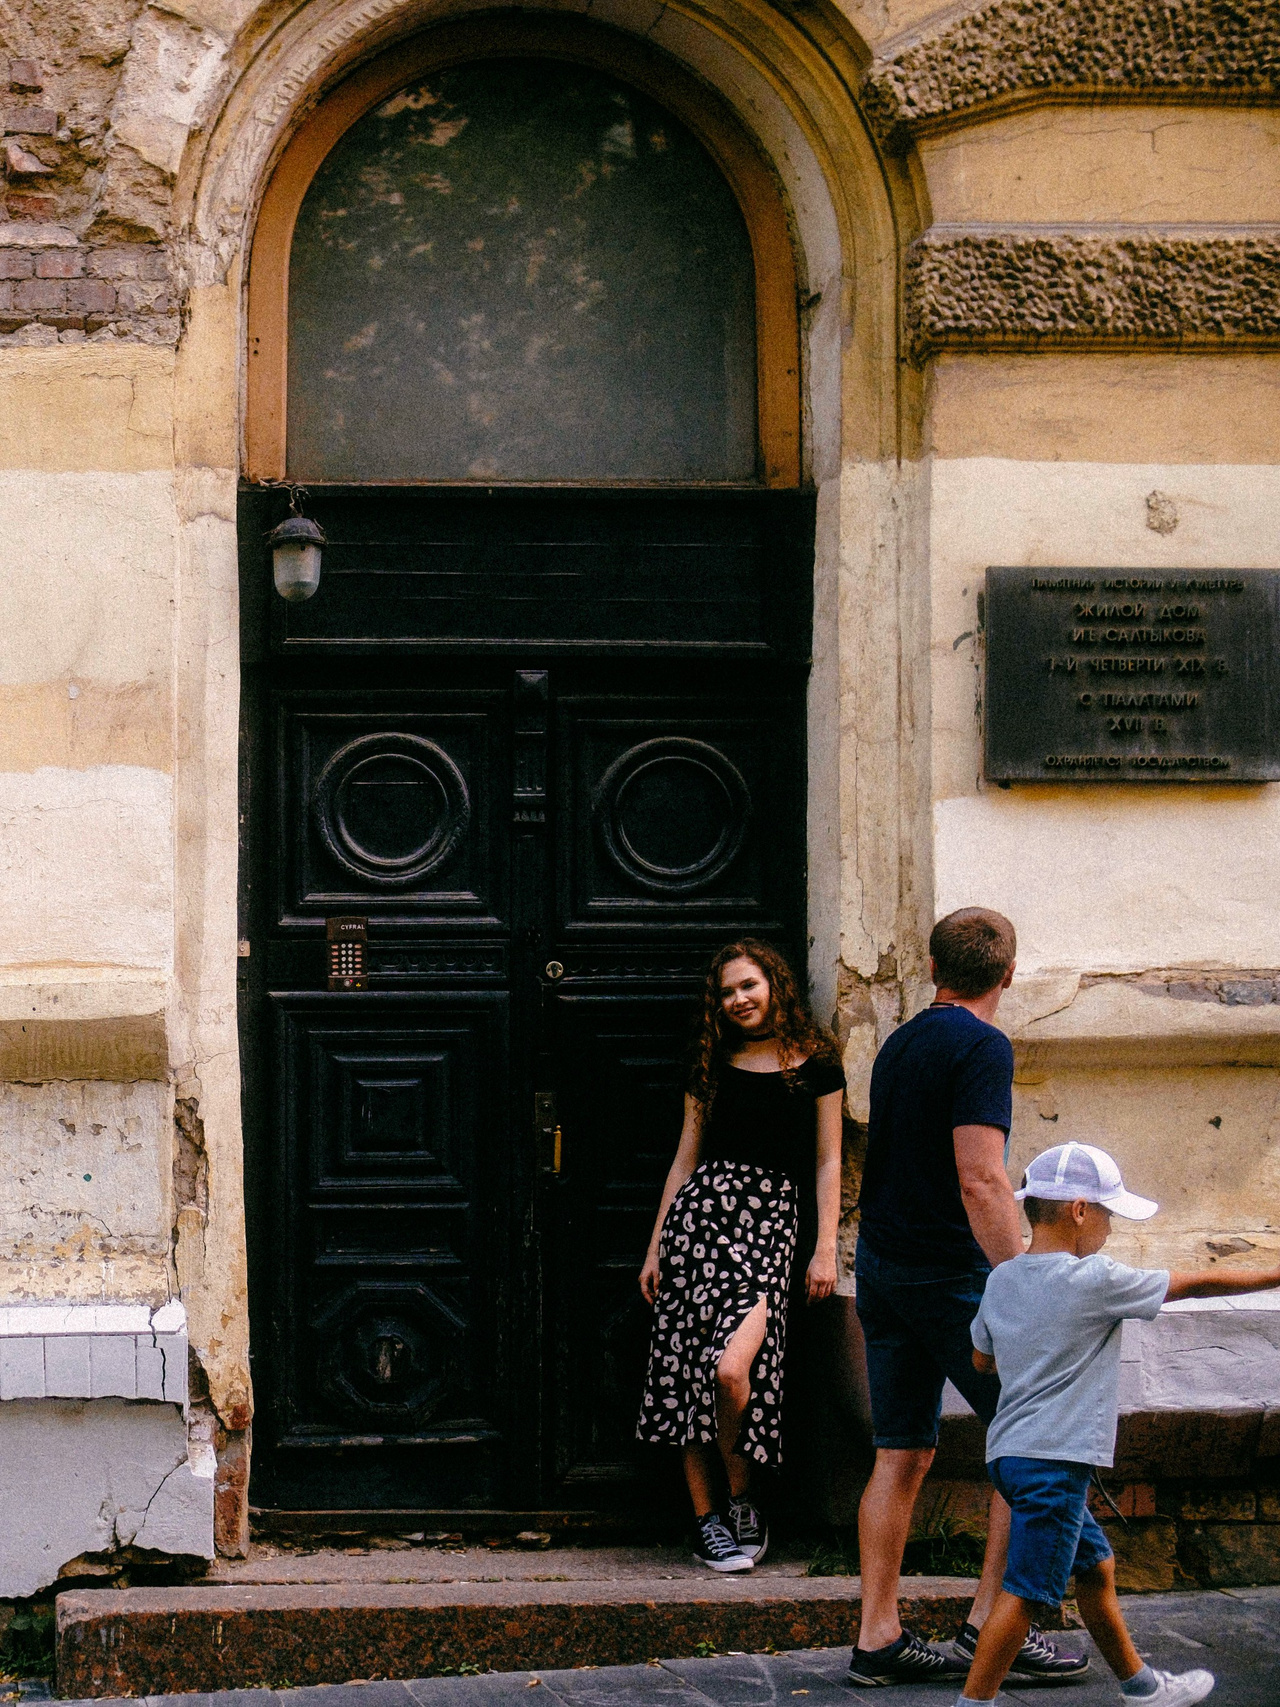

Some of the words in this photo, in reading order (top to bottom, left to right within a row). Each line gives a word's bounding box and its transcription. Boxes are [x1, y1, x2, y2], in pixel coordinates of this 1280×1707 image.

[1031, 578, 1096, 590] ПАМЯТНИК
[1104, 578, 1164, 590] ИСТОРИИ
[1076, 602, 1147, 618] ЖИЛОЙ
[1159, 603, 1202, 618] ДОМ
[1090, 657, 1167, 672] ЧЕТВЕРТИ
[1079, 692, 1093, 706] С
[1103, 692, 1200, 707] ПАЛАТАМИ
[1045, 755, 1123, 767] ОХРАНЯЕТСЯ
[1131, 755, 1231, 767] ГОСУДАРСТВОМ
